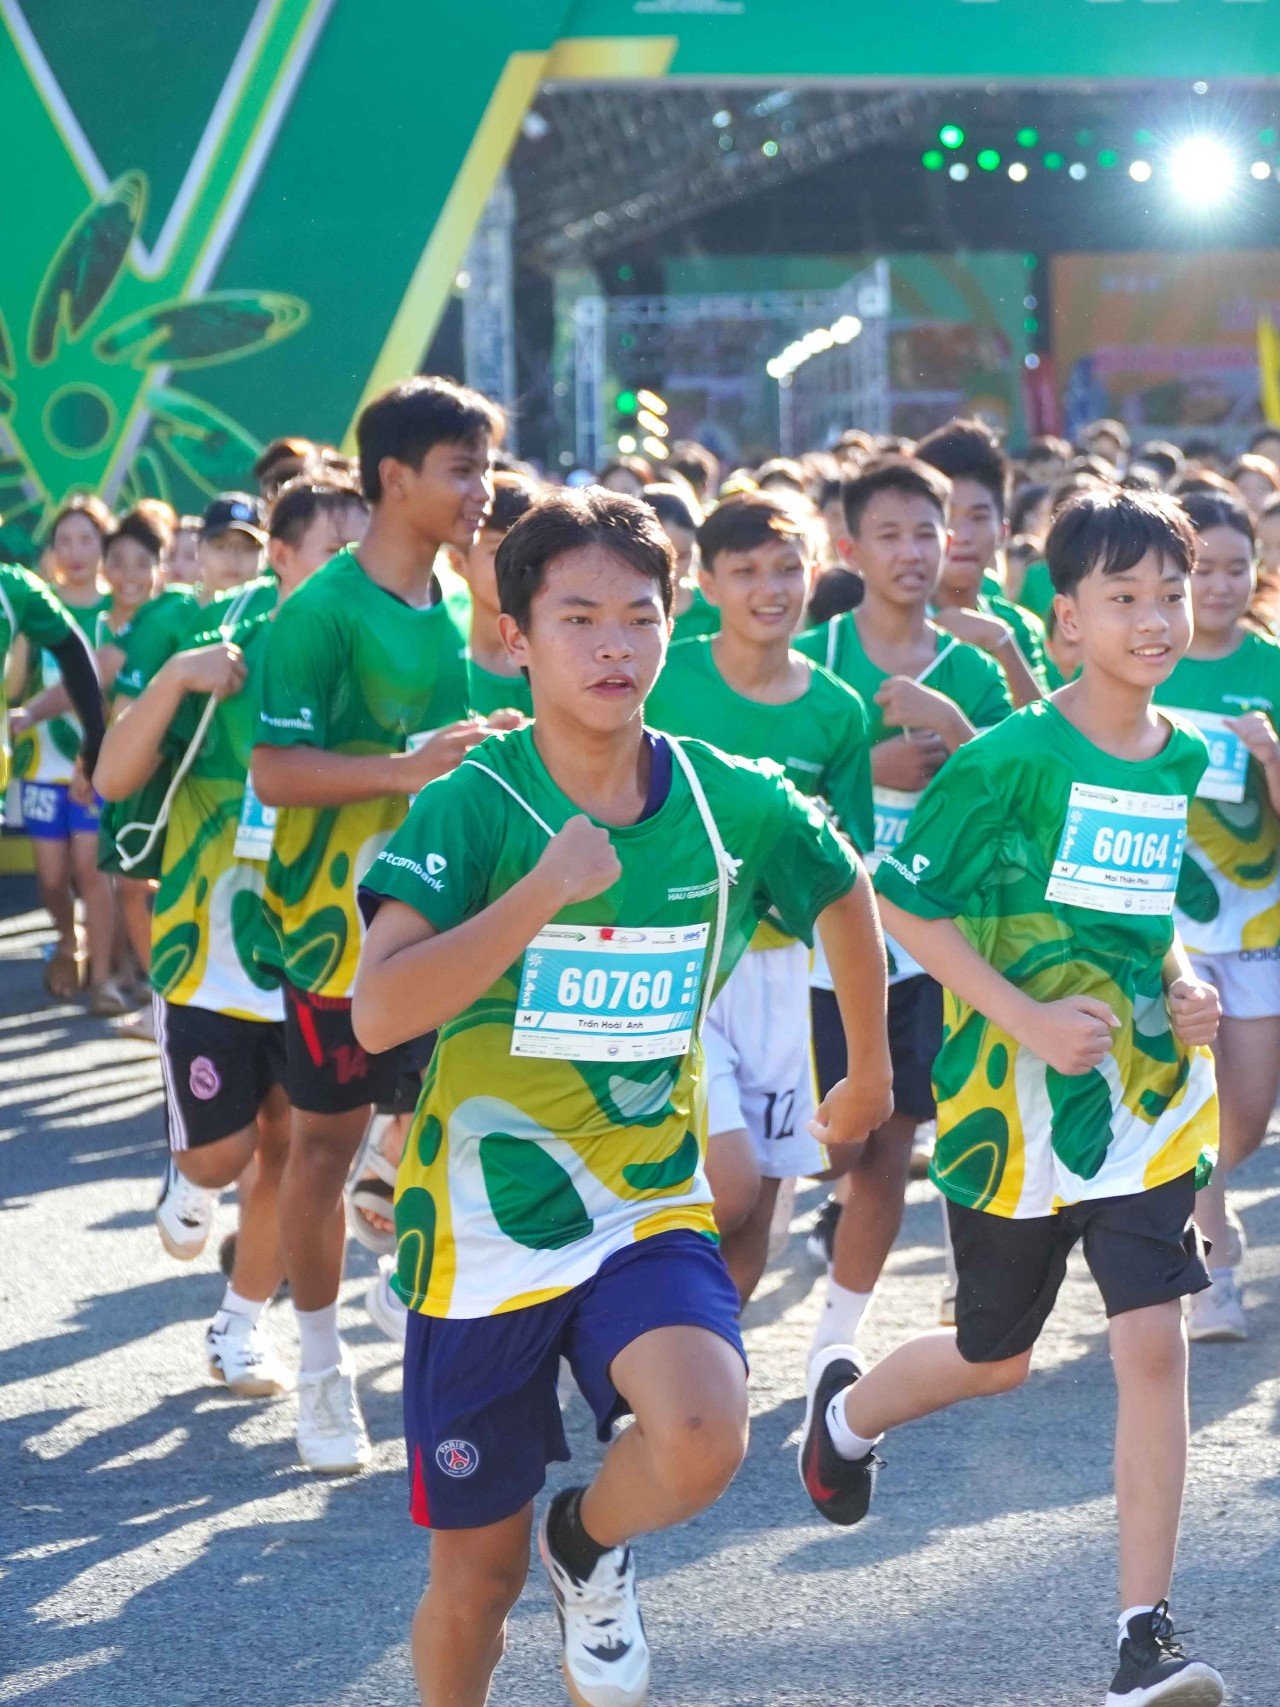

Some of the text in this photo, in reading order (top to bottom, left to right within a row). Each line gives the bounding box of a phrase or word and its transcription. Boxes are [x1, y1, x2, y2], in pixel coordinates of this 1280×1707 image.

[1092, 826, 1171, 869] 60164
[556, 967, 674, 1011] 60760
[523, 1015, 532, 1023] M
[626, 1021, 644, 1029] Anh
[762, 1089, 796, 1140] 12
[440, 1440, 466, 1454] PARIS
